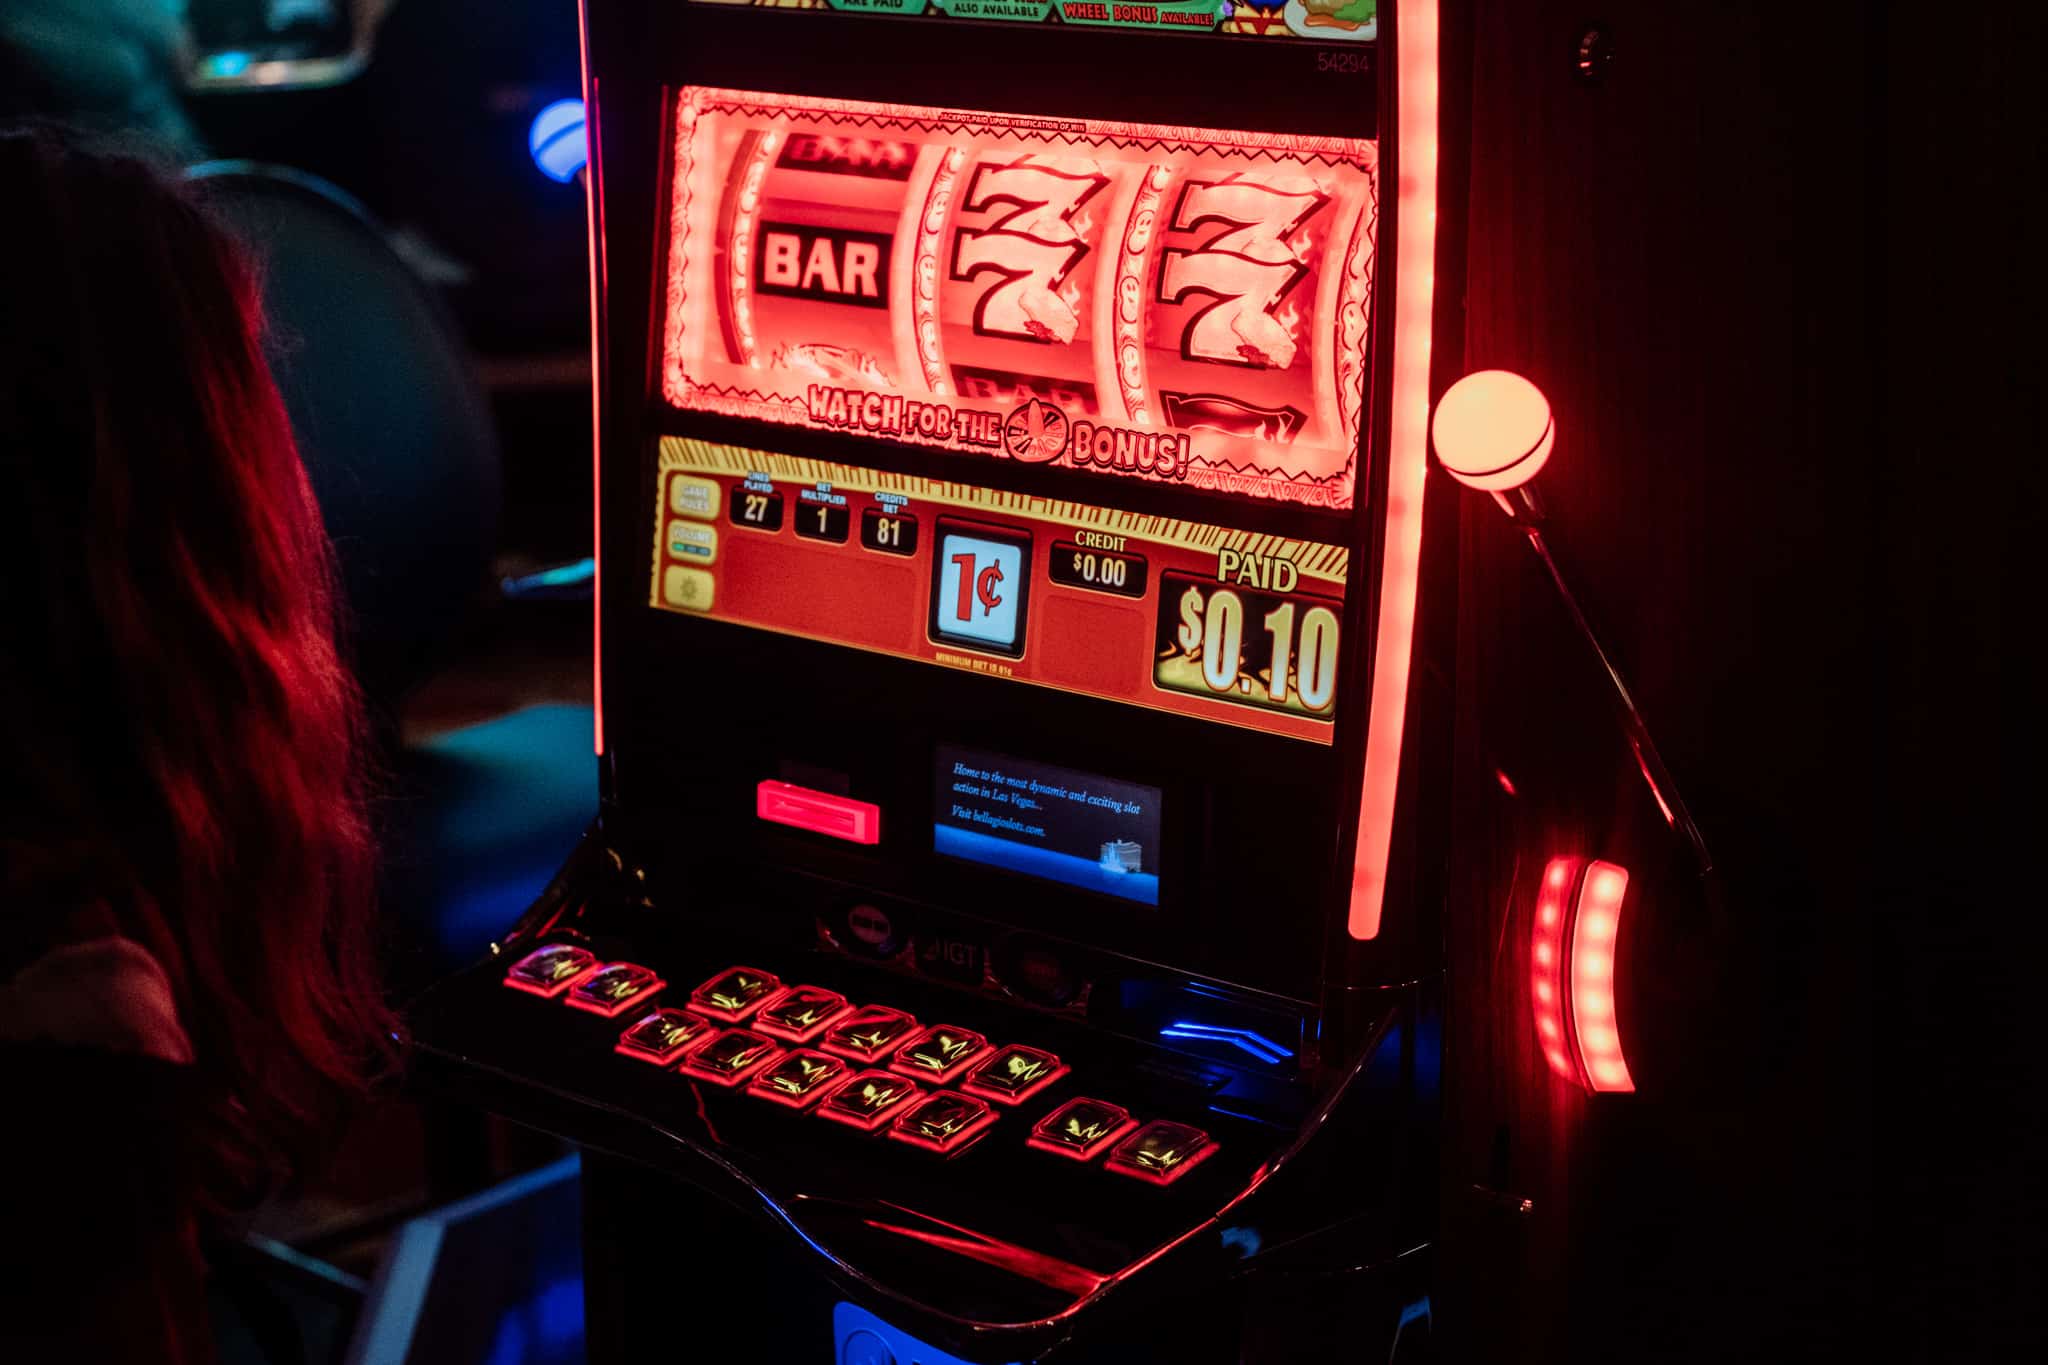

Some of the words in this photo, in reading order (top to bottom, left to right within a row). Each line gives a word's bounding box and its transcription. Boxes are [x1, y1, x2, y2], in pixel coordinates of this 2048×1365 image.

[954, 3, 978, 14] ALSO
[983, 4, 1039, 17] AVAILABLE
[1063, 3, 1108, 20] WHEEL
[1112, 5, 1157, 24] BONUS
[1160, 11, 1214, 26] AVAILABLE!
[1318, 52, 1369, 73] 54294
[1011, 119, 1058, 130] VERIFICATION
[764, 233, 879, 297] BAR
[807, 384, 904, 434] WATCH
[905, 401, 951, 440] FOR
[955, 409, 1002, 447] THE
[1072, 420, 1191, 480] BONUS!
[745, 494, 769, 522] 27
[801, 489, 847, 505] MULTIPLIER
[875, 491, 908, 506] CREDITS
[816, 507, 828, 533] 1
[877, 518, 900, 547] 81
[1075, 530, 1127, 552] CREDIT
[1073, 552, 1127, 587] $0.00
[1217, 548, 1298, 592] PAID
[952, 553, 1004, 622] 1¢
[1178, 585, 1339, 711] $0.10
[953, 762, 981, 779] Home
[981, 771, 989, 781] to
[991, 771, 1006, 784] the
[1007, 775, 1028, 789] most
[1029, 780, 1067, 798] dynamic
[1068, 789, 1087, 803] and
[1087, 794, 1122, 813] exciting
[1123, 802, 1141, 815] slot
[953, 782, 980, 795] action
[981, 786, 990, 798] in
[992, 790, 1009, 802] Las
[952, 805, 972, 820] Visit
